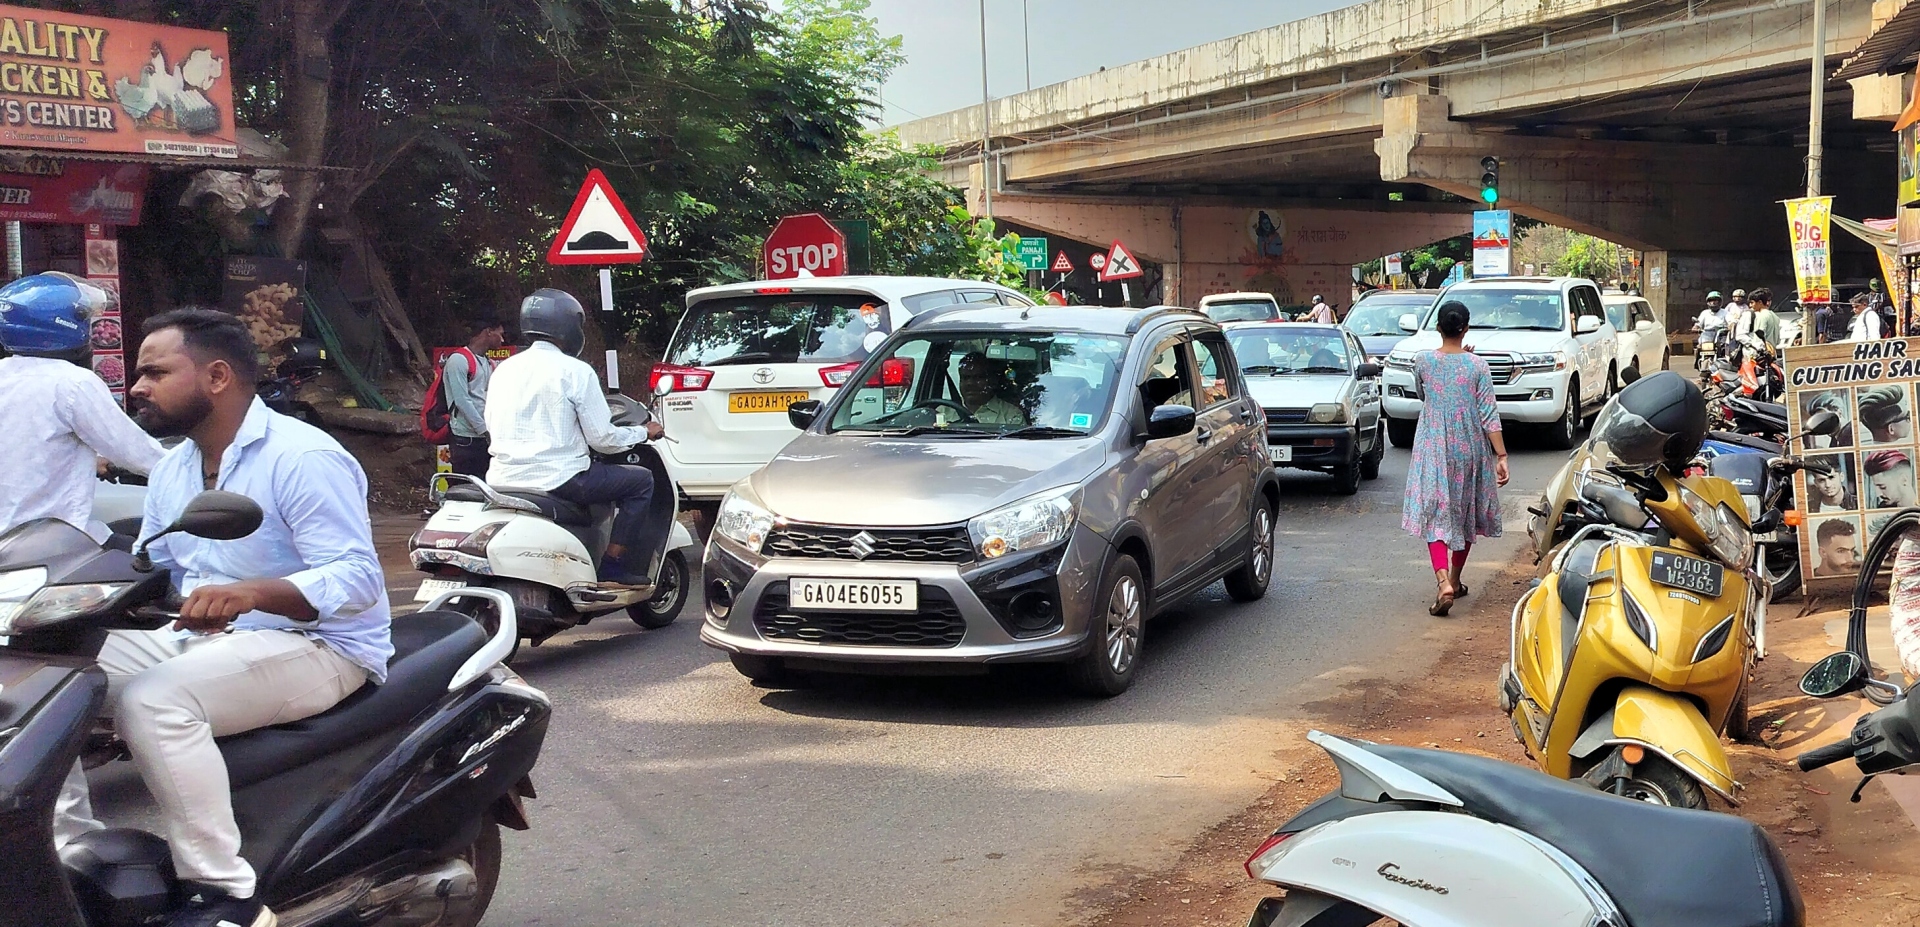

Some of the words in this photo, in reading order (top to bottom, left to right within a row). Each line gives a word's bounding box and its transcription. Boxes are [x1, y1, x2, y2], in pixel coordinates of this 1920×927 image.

[87, 70, 110, 99] &
[26, 102, 114, 129] CENTER
[1794, 221, 1821, 241] BIG
[771, 243, 838, 274] STOP
[1854, 340, 1907, 360] HAIR
[1792, 361, 1883, 386] CUTTING
[1674, 556, 1711, 576] GA03
[1667, 569, 1714, 593] W5365
[804, 584, 903, 604] GA04E6055
